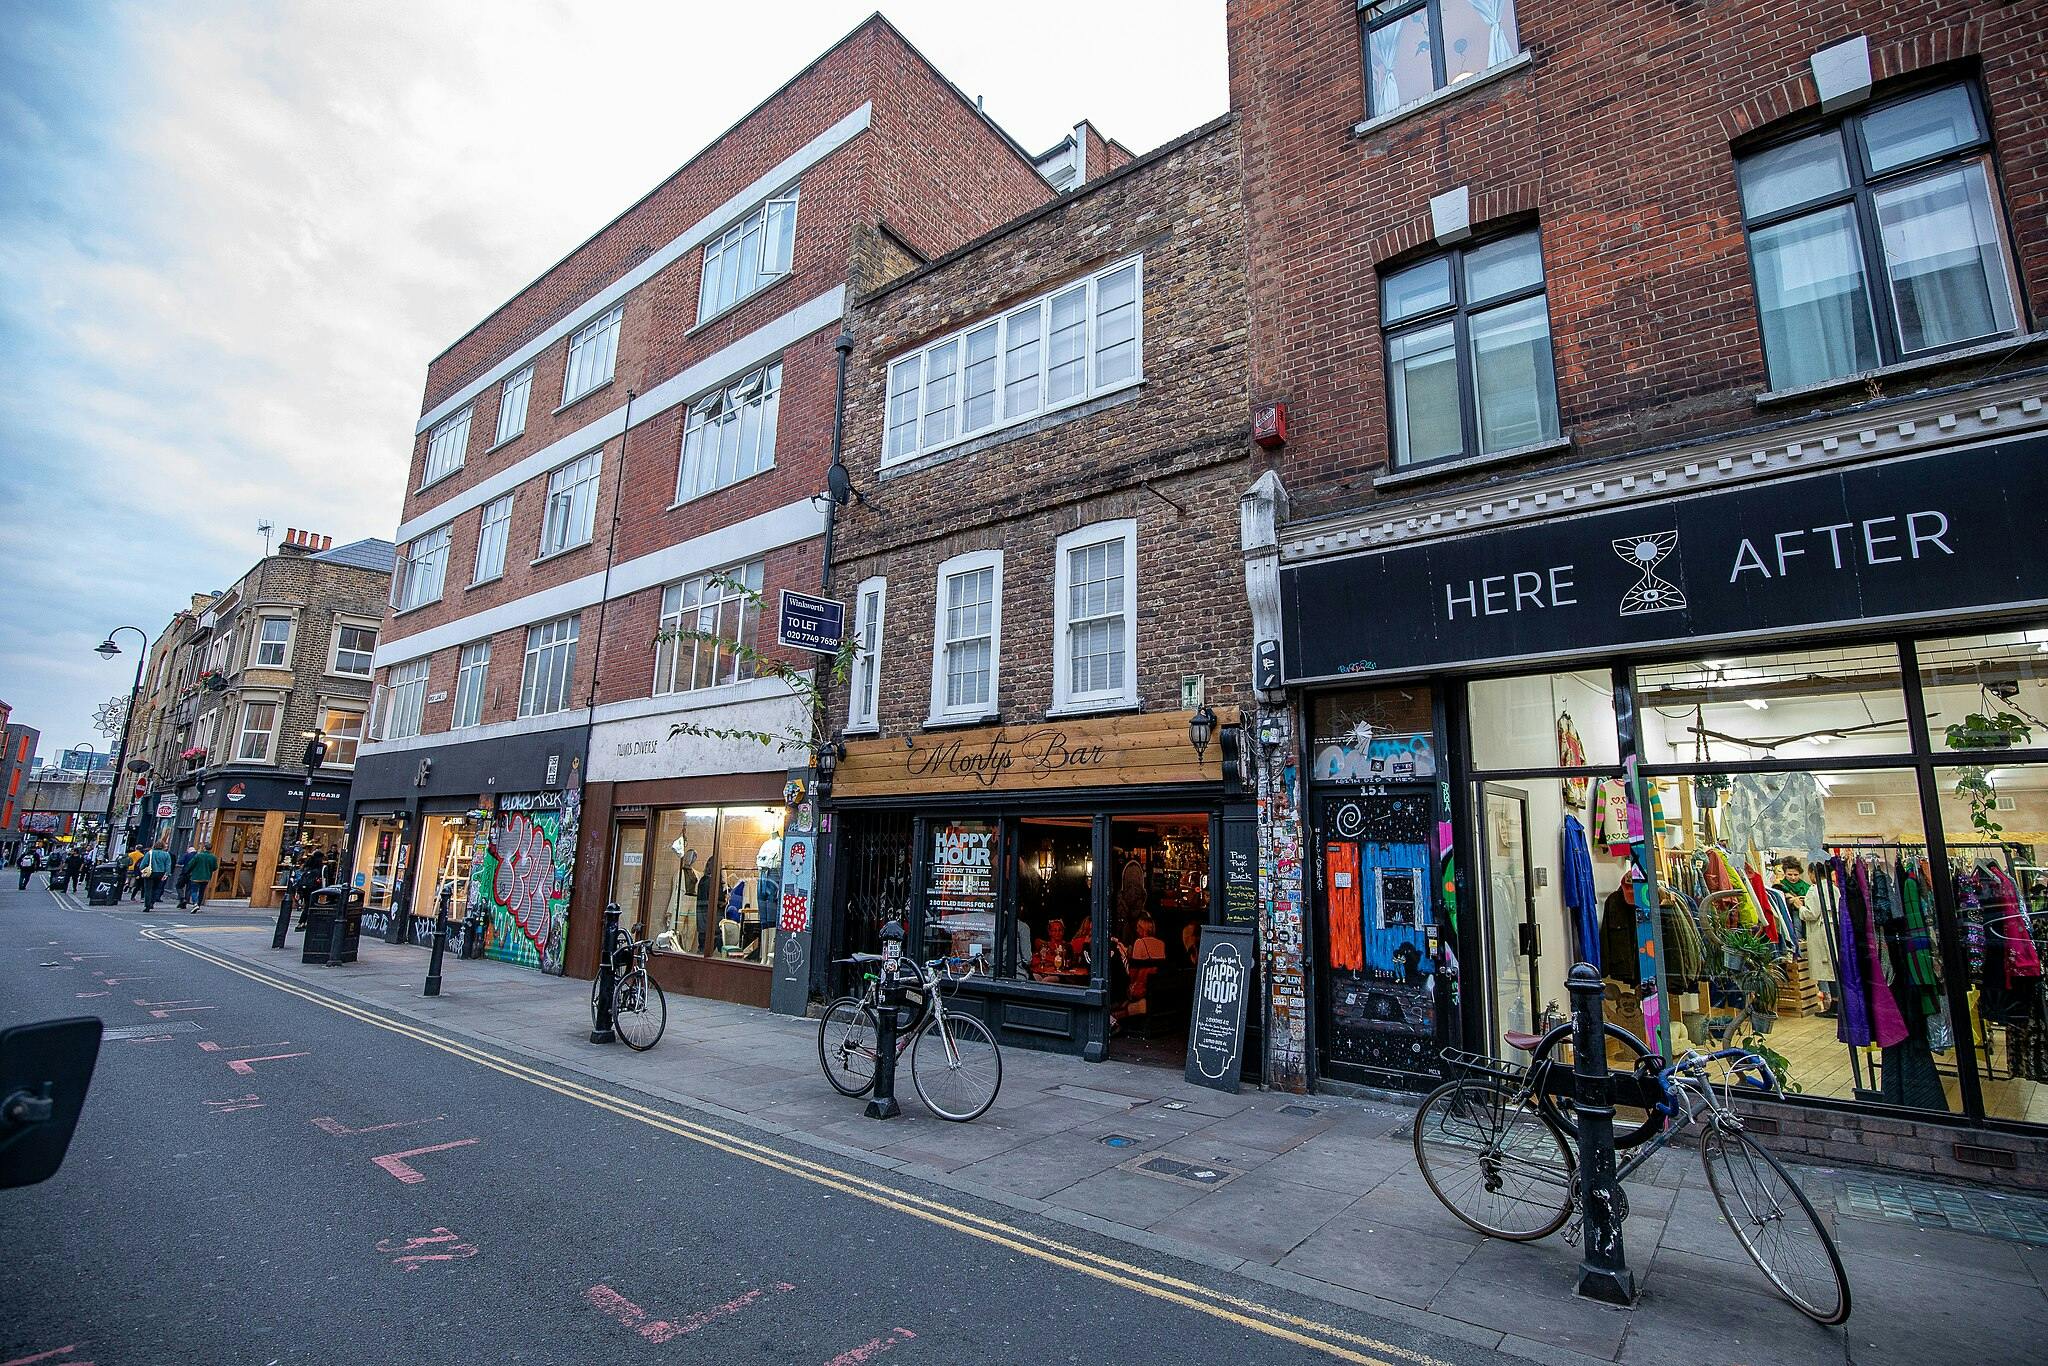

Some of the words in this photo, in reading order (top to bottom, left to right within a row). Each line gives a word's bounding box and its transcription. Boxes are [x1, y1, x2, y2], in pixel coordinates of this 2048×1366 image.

[1446, 565, 1577, 621] HERE
[1729, 510, 1955, 584] AFTER
[788, 597, 825, 612] Winkworth
[787, 617, 800, 628] TO
[801, 619, 818, 631] LET
[786, 630, 800, 640] 020
[801, 632, 819, 643] 7749
[820, 636, 838, 647] 7650
[906, 731, 1015, 786] Montys
[1022, 729, 1105, 780] Bar
[310, 791, 341, 799] SUGARS
[1360, 785, 1387, 796] 151
[160, 807, 172, 815] STOP
[935, 832, 992, 848] HAPPY
[934, 846, 991, 866] HOUR
[1229, 850, 1247, 860] PING
[1228, 871, 1252, 880] BACK
[974, 901, 986, 909] FOR
[1205, 964, 1239, 984] HAPPY
[1204, 980, 1237, 1003] HOUR
